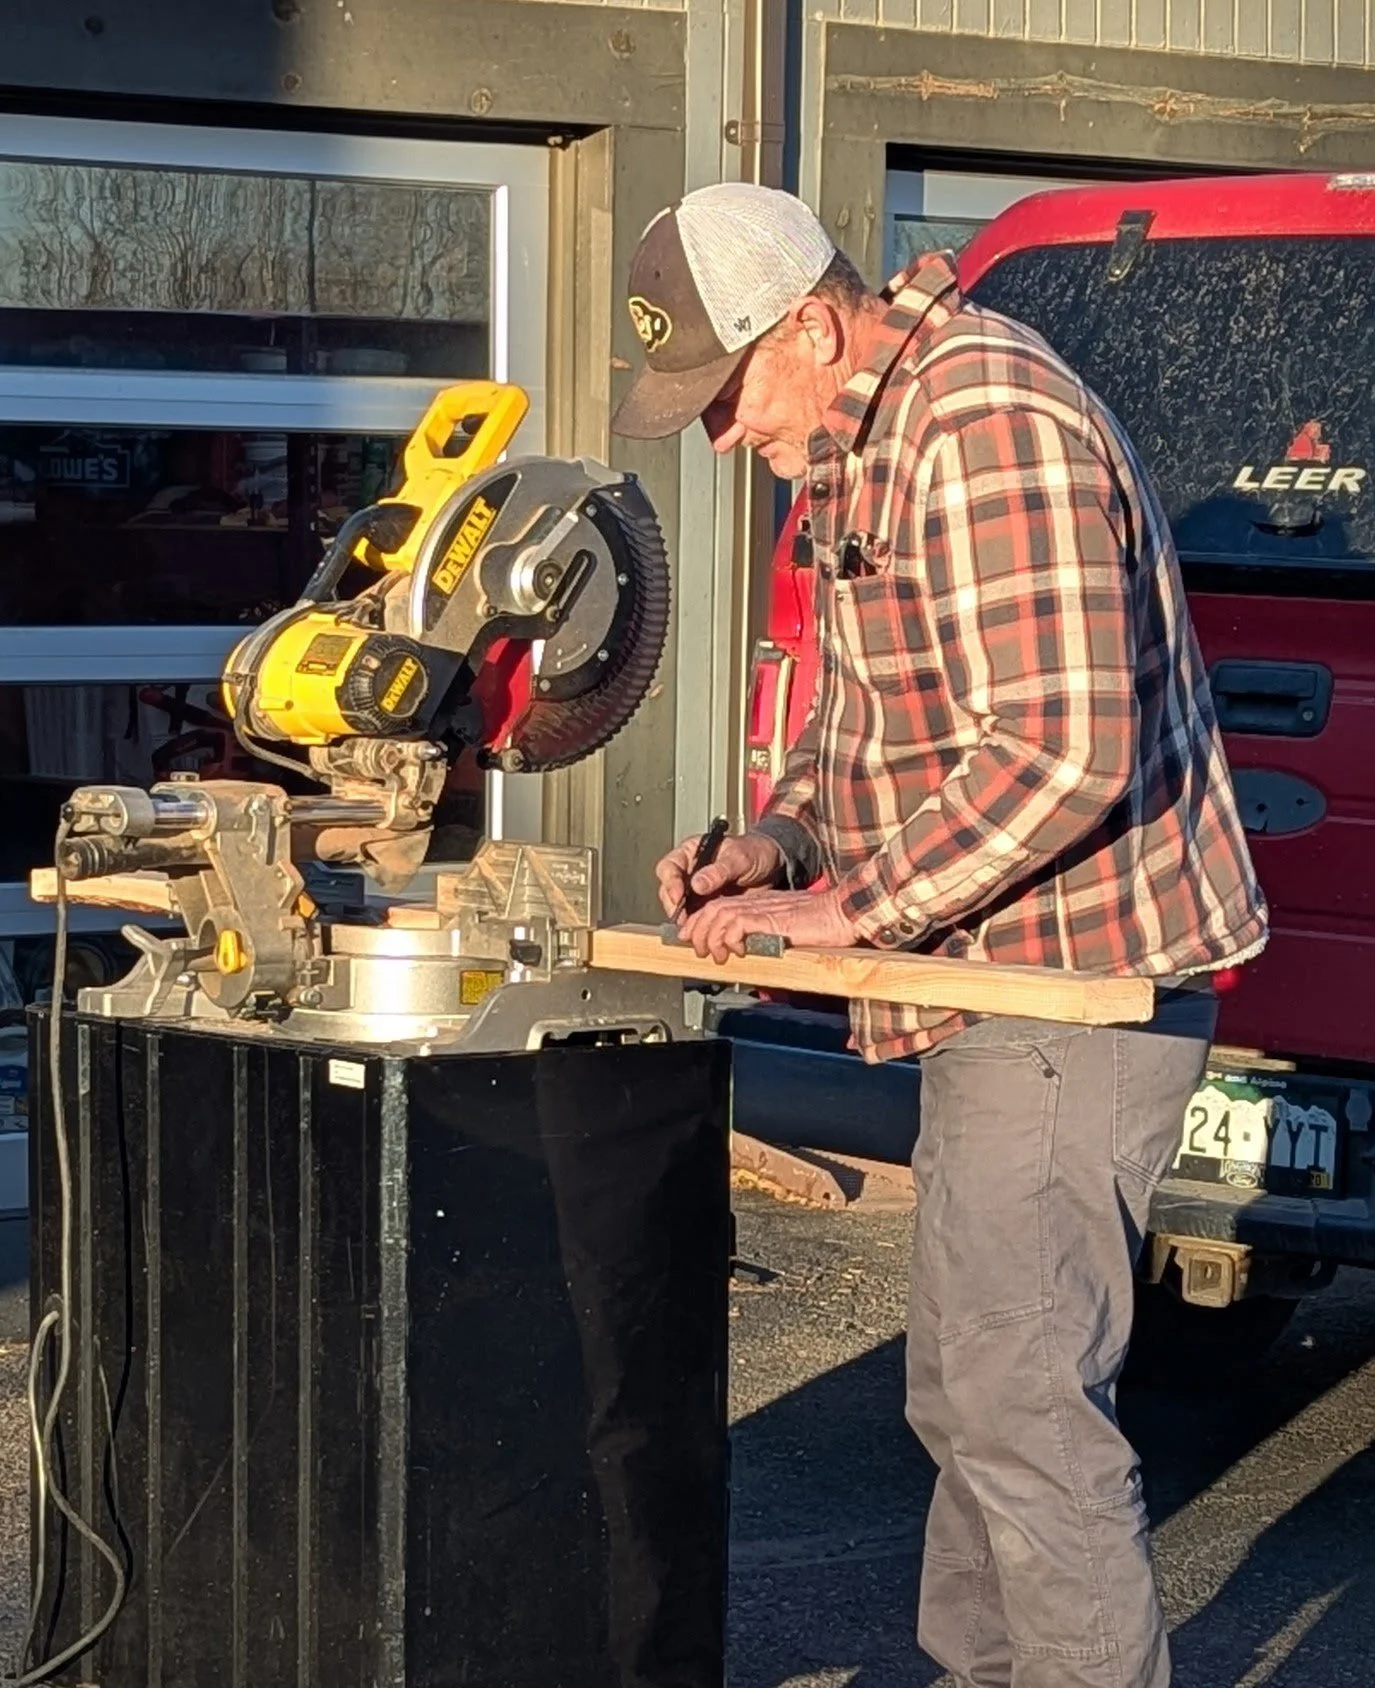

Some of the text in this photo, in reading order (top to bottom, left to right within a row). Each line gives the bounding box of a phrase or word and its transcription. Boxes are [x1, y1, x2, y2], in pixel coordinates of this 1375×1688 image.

[1232, 466, 1367, 492] LEER
[432, 496, 497, 595] DEWALT
[380, 657, 419, 713] DEWALT
